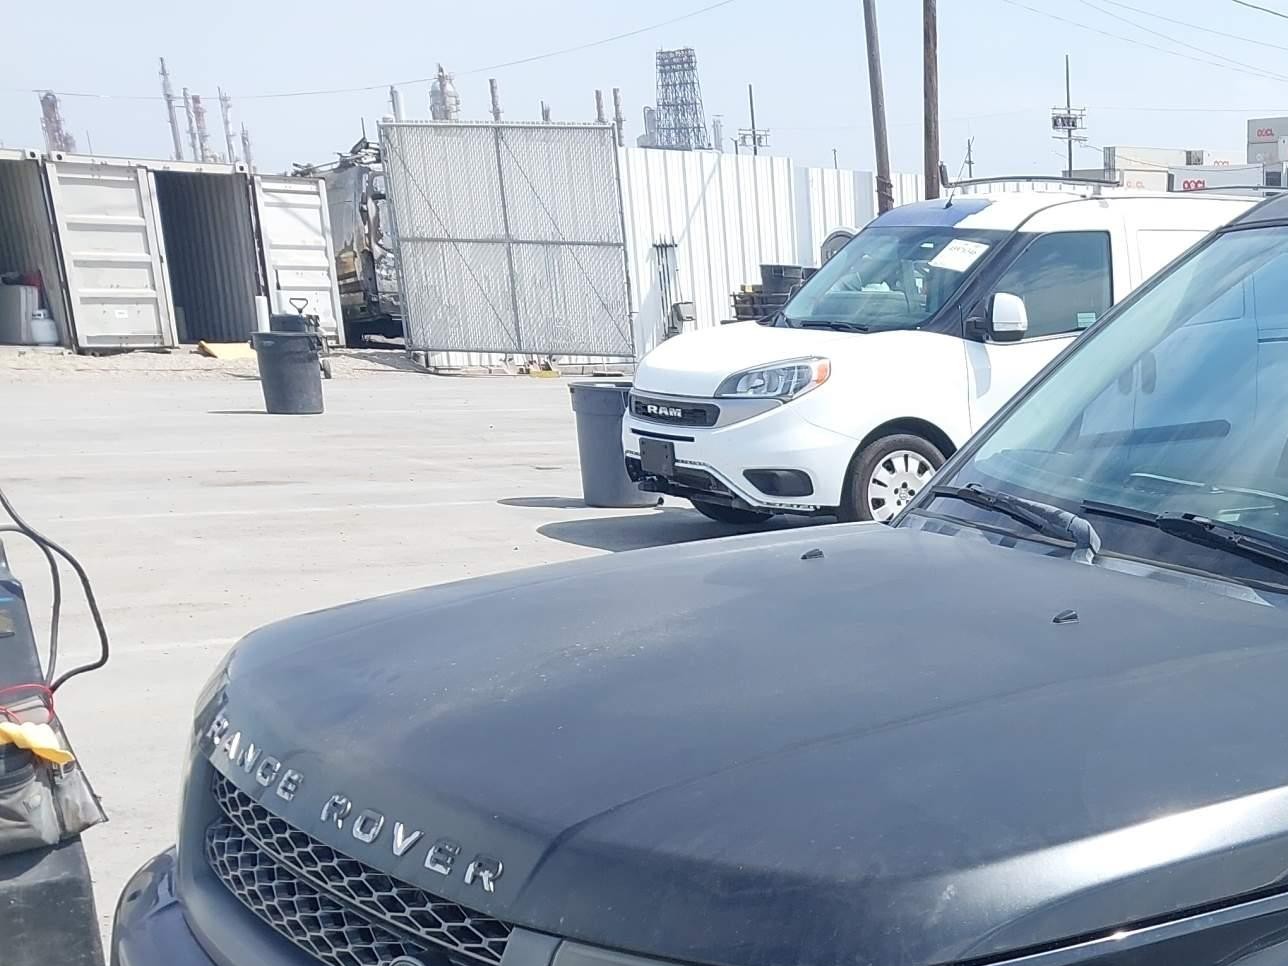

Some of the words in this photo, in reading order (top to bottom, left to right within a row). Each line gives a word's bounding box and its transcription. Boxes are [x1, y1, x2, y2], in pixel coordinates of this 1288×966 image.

[647, 404, 682, 418] RAM
[205, 711, 304, 801] RANGE
[320, 792, 504, 893] ROVER
